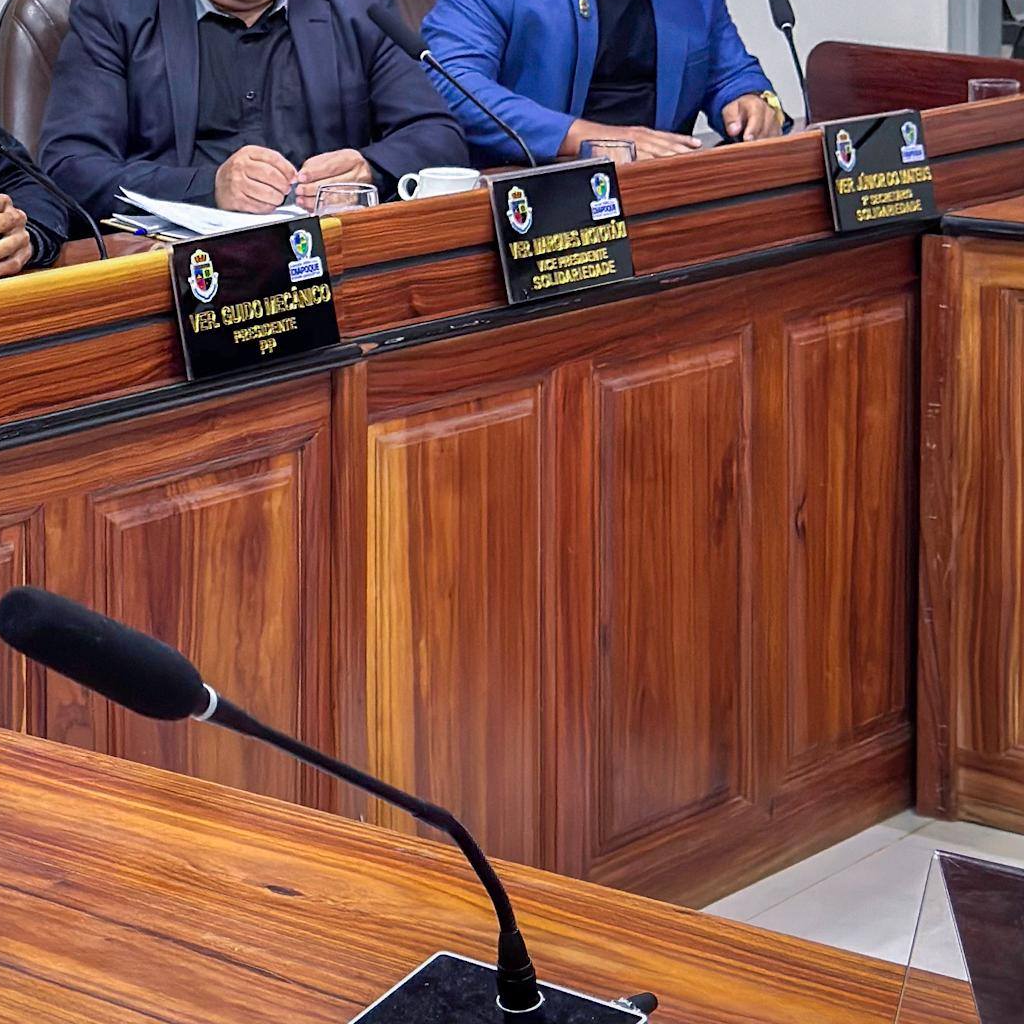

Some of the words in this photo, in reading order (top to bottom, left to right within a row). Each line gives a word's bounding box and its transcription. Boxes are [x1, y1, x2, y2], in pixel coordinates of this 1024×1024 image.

[532, 260, 617, 290] SOLIDARIEDADE
[221, 299, 264, 326] GUIDO
[263, 284, 332, 317] MECÂNICO
[233, 317, 299, 344] PRESIDENTE
